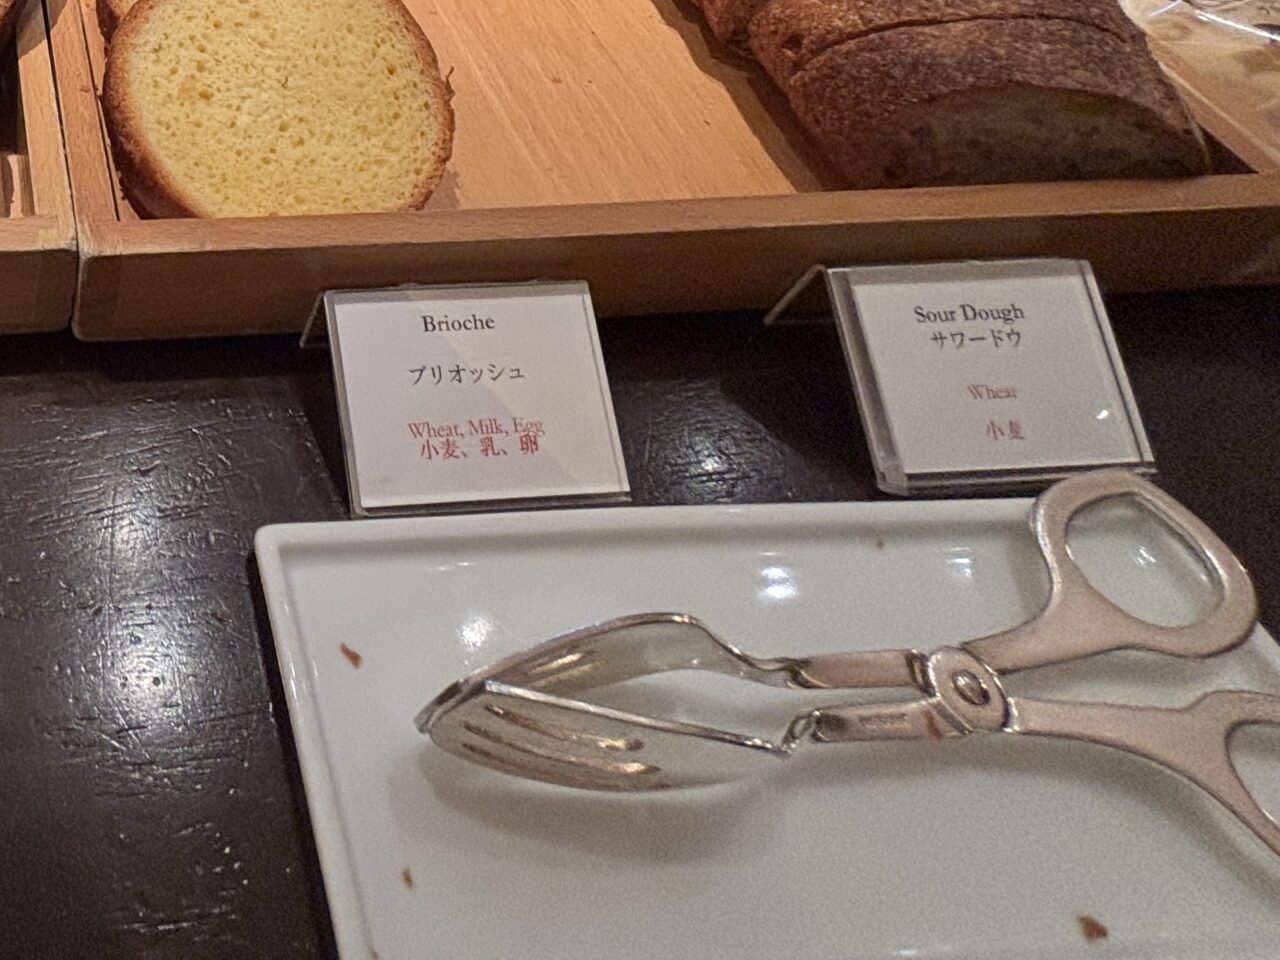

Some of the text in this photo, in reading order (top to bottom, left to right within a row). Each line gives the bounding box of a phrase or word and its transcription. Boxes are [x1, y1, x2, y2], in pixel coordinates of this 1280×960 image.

[420, 313, 497, 333] Brioche
[913, 302, 1026, 325] Sour Dough
[929, 327, 1022, 349] サワードウ
[408, 363, 526, 386] ブリオッシュ
[407, 420, 465, 439] Wheat,
[466, 417, 510, 437] Milk,
